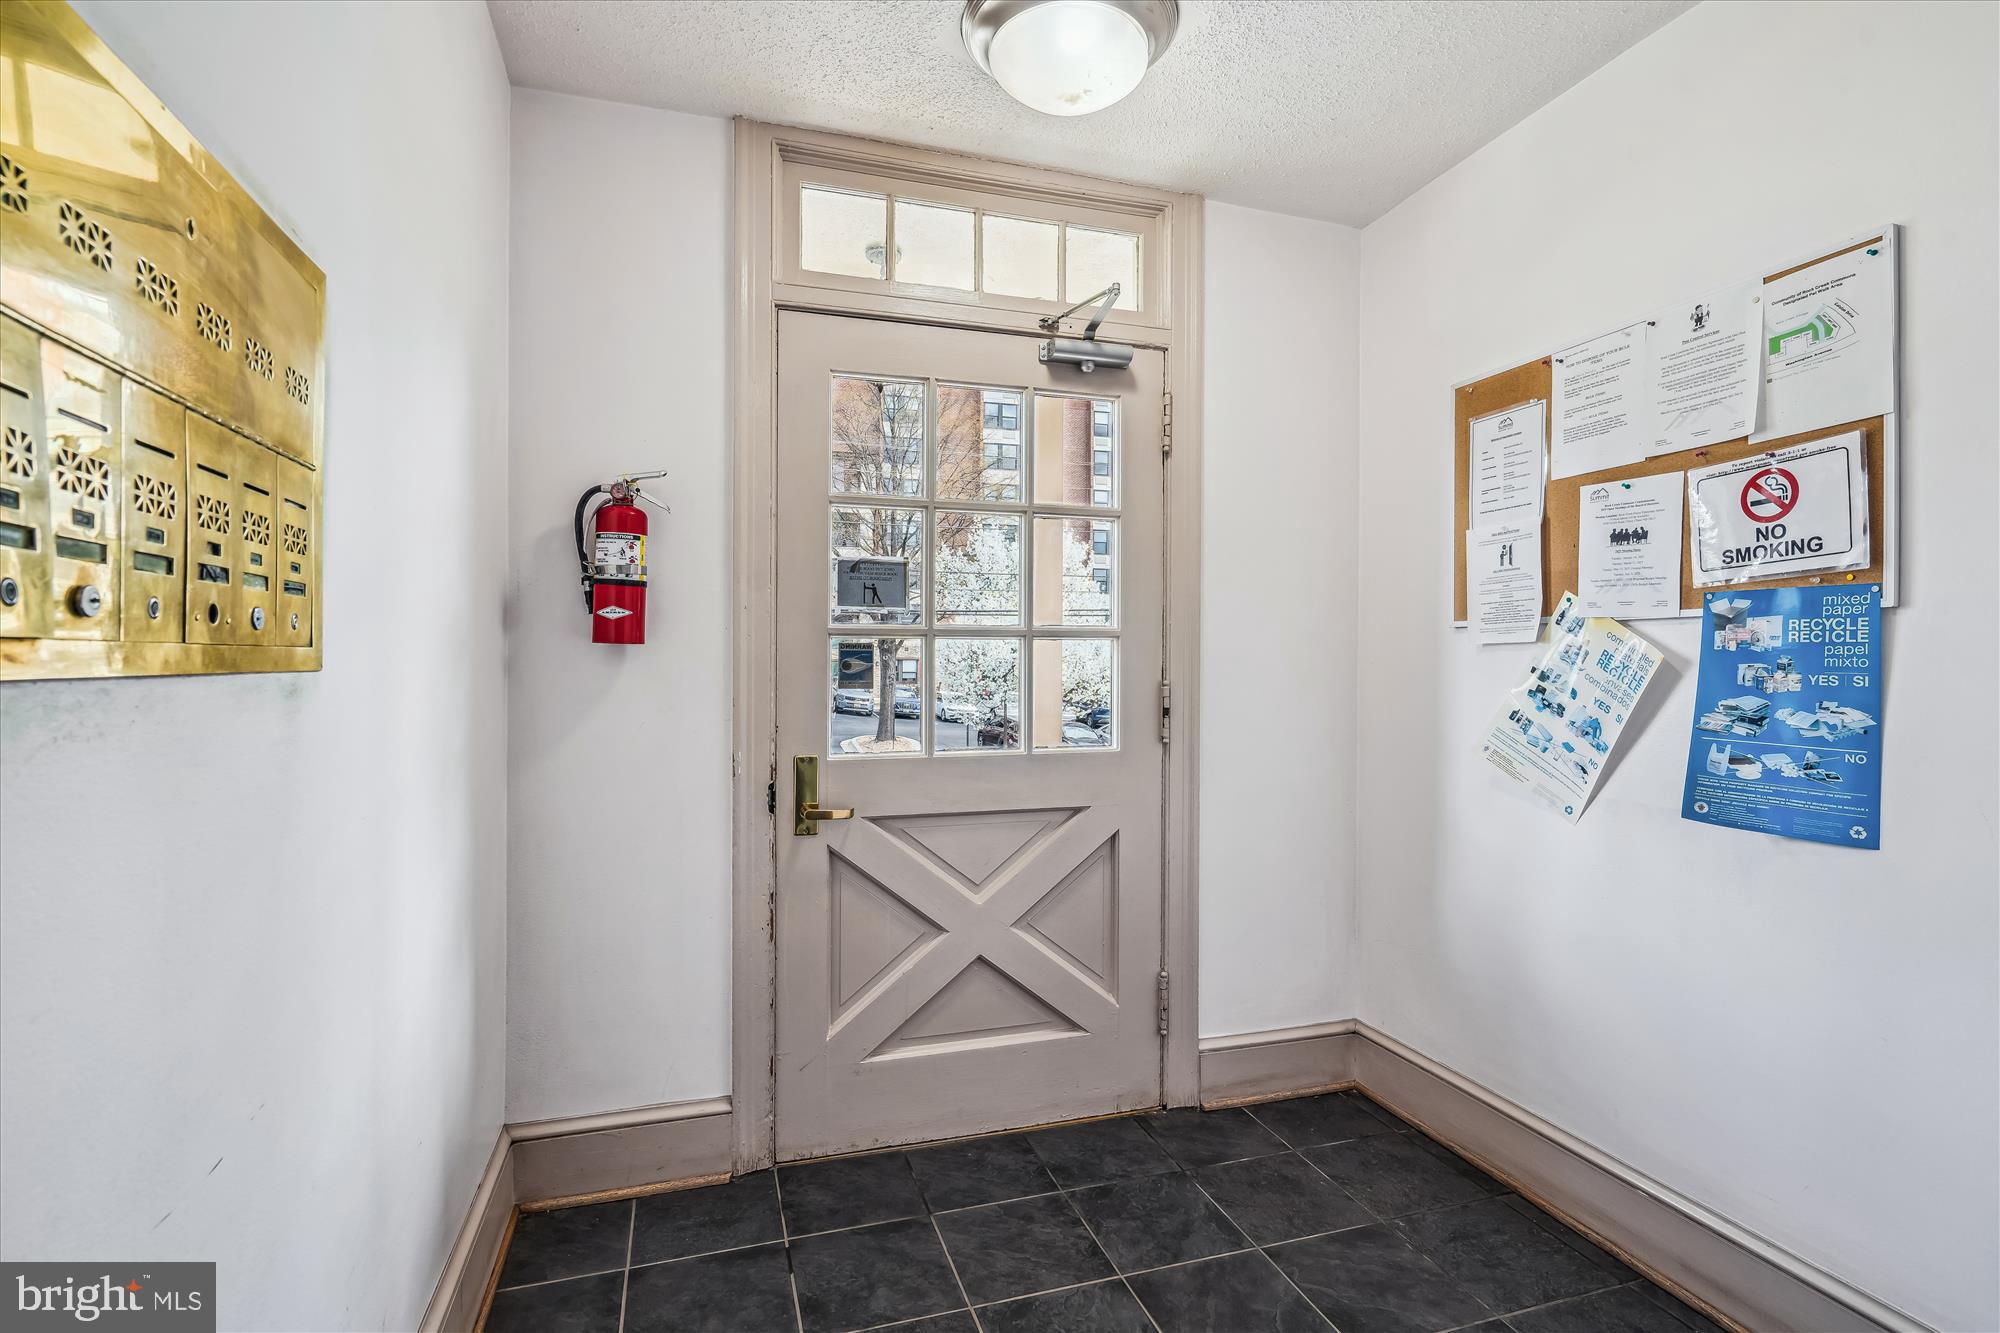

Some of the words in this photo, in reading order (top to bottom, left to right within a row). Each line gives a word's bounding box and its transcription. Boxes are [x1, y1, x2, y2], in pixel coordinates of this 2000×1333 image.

[1755, 523, 1787, 542] NO
[1722, 536, 1823, 565] SMOKING
[1823, 592, 1870, 605] mixed
[1822, 604, 1868, 617] paper
[1788, 618, 1869, 631] RECYCLE
[1788, 631, 1869, 643] RECICLE
[1824, 644, 1868, 657] papel
[1824, 656, 1868, 668] mixto
[1808, 675, 1839, 686] YES
[1852, 676, 1869, 687] SI
[1584, 672, 1630, 711] combinados
[1593, 697, 1612, 714] YES
[1588, 758, 1599, 770] NO
[1844, 754, 1867, 764] NO
